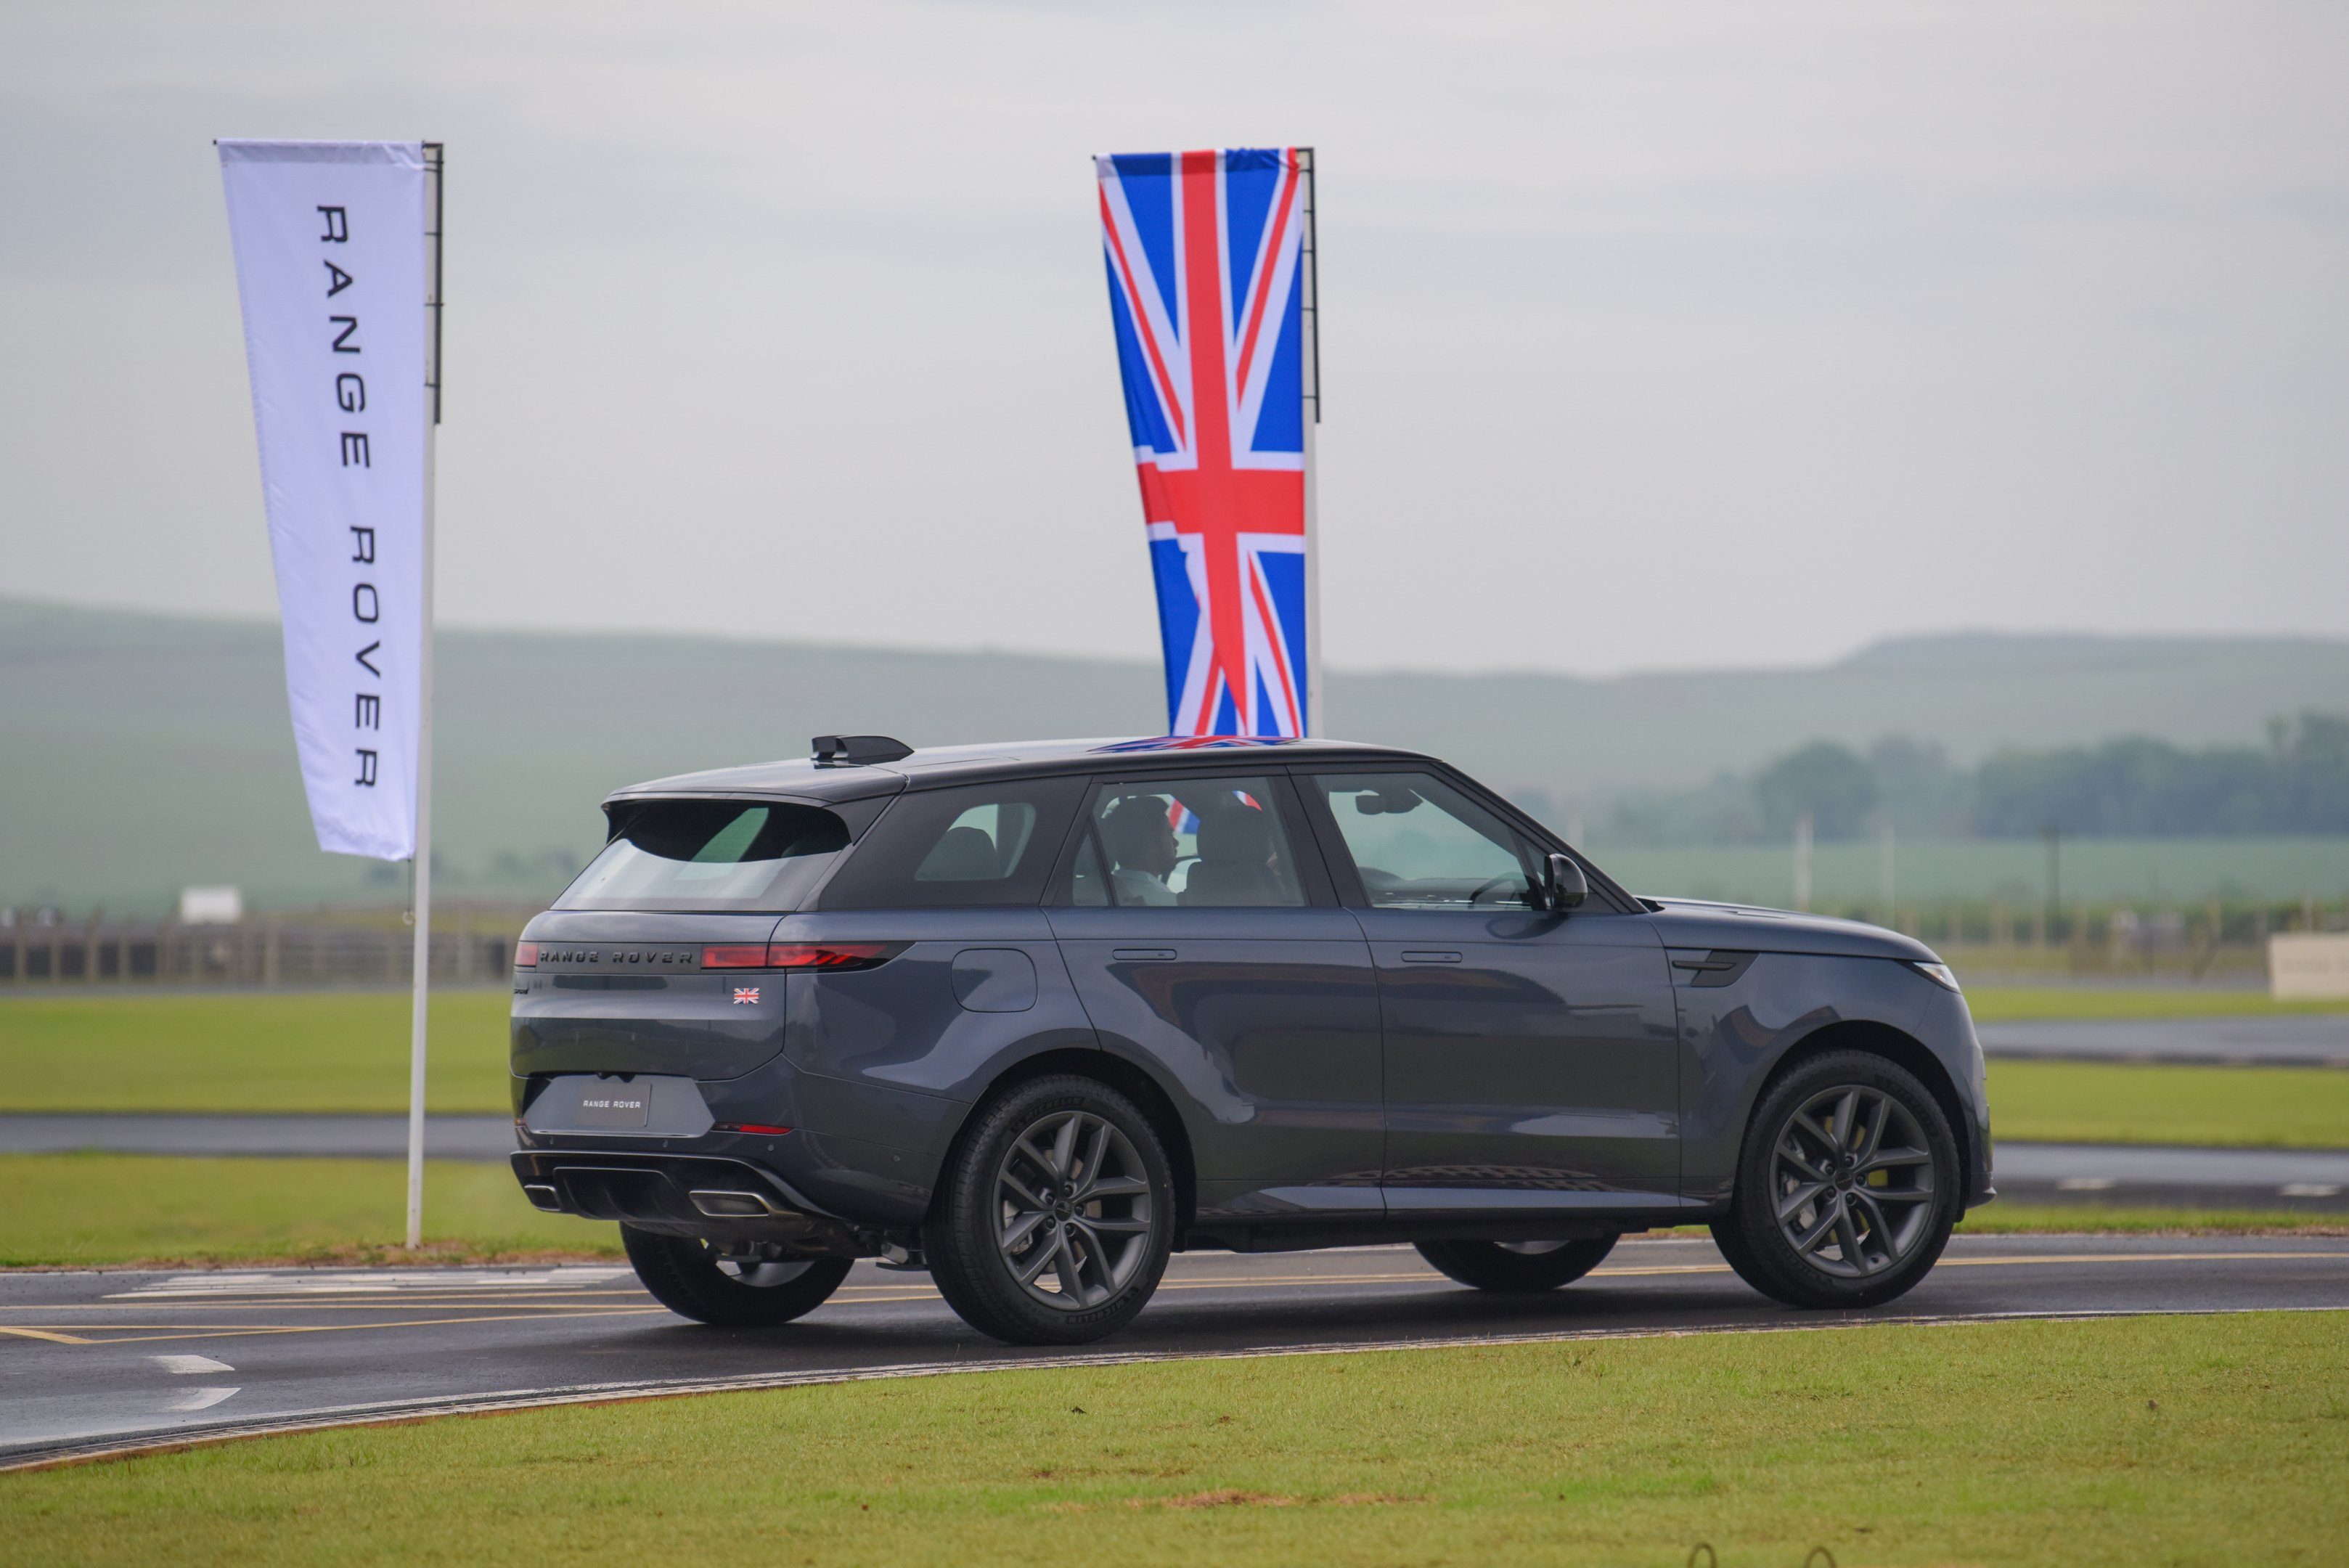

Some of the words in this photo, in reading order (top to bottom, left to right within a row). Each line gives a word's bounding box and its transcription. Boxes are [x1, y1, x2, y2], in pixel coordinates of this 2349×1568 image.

[316, 205, 370, 468] RANGE
[350, 525, 381, 788] ROVER
[540, 951, 599, 963] RANGE
[612, 951, 693, 964] ROVER
